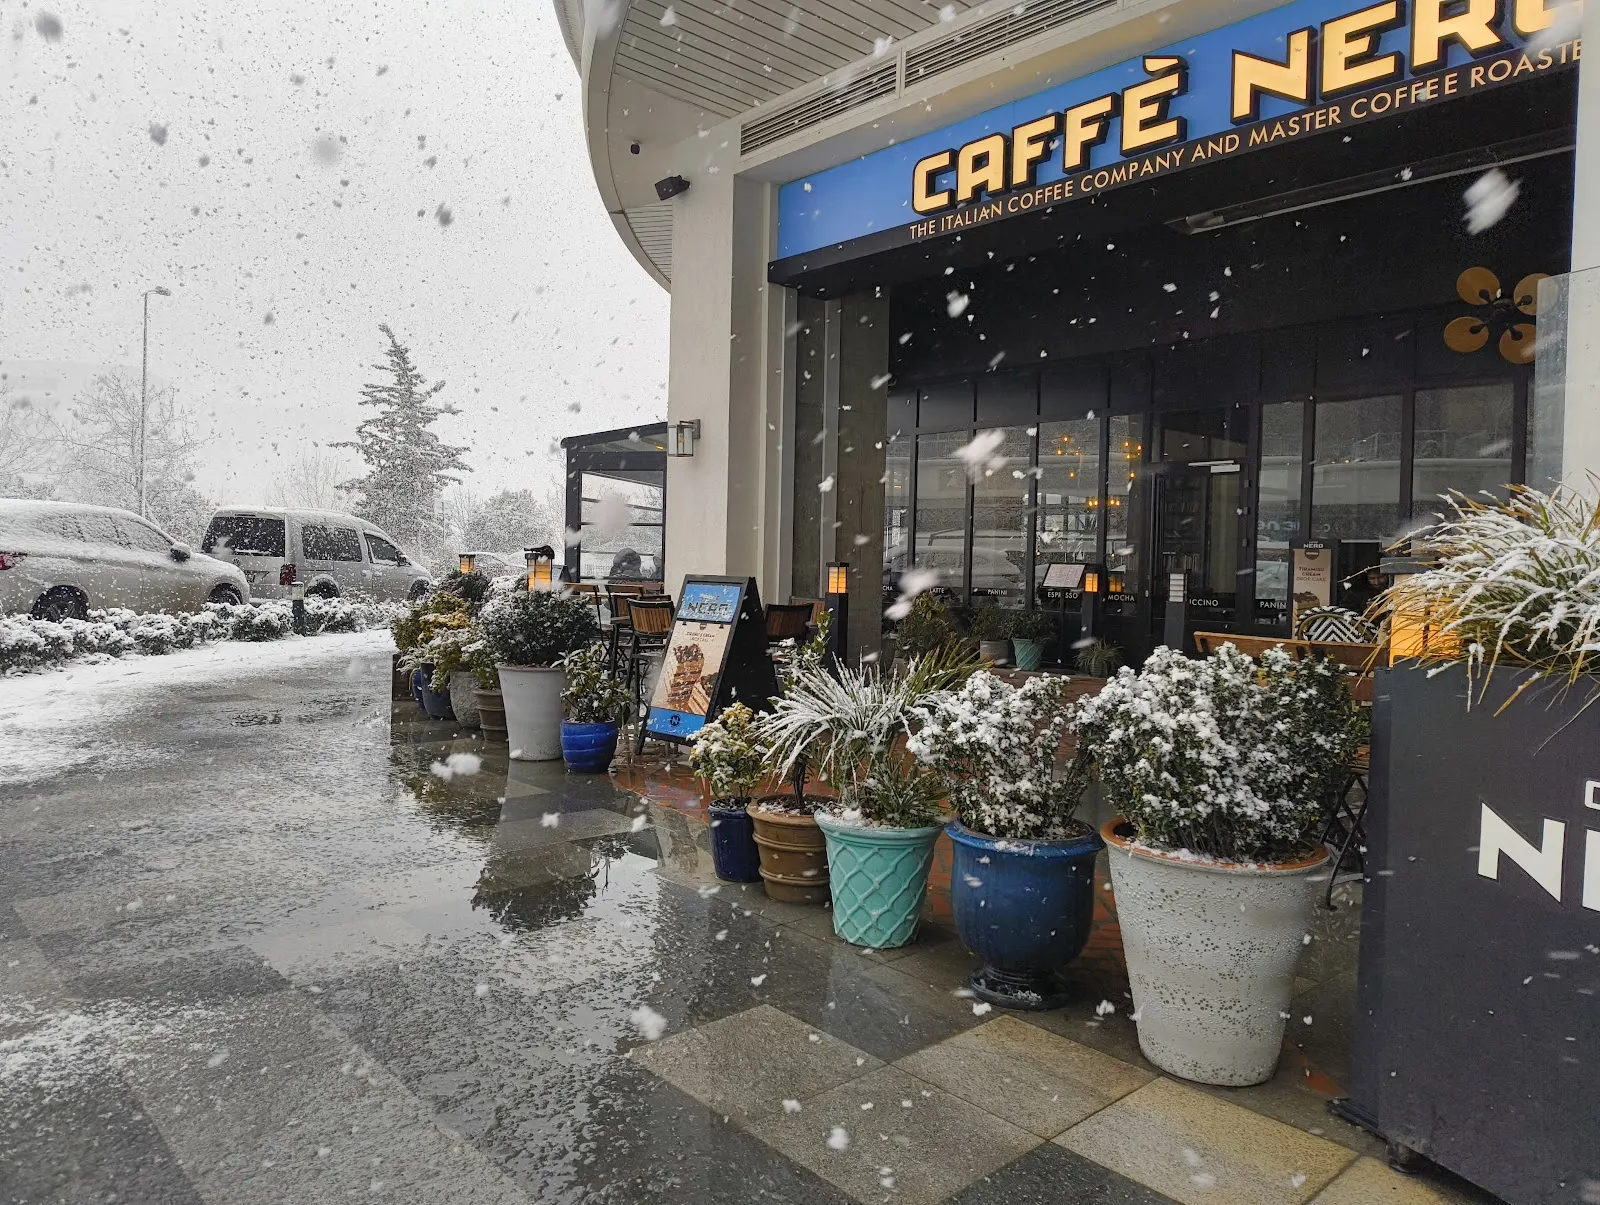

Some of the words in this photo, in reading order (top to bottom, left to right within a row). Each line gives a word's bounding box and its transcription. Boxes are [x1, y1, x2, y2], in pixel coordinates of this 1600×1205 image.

[912, 56, 1188, 215] CAFFÈ
[909, 219, 937, 240] THE
[941, 200, 1003, 232] ITALIAN
[1007, 180, 1075, 213] COFFEE
[1080, 148, 1185, 192] COMPANY
[1191, 133, 1240, 163] AND
[1248, 105, 1342, 148] MASTER
[1350, 72, 1458, 120] COFFEE
[987, 588, 1008, 596] PANINI
[1047, 591, 1079, 599] ESPSSO
[1107, 594, 1135, 602] MOCHA
[1189, 598, 1219, 607] CCINO
